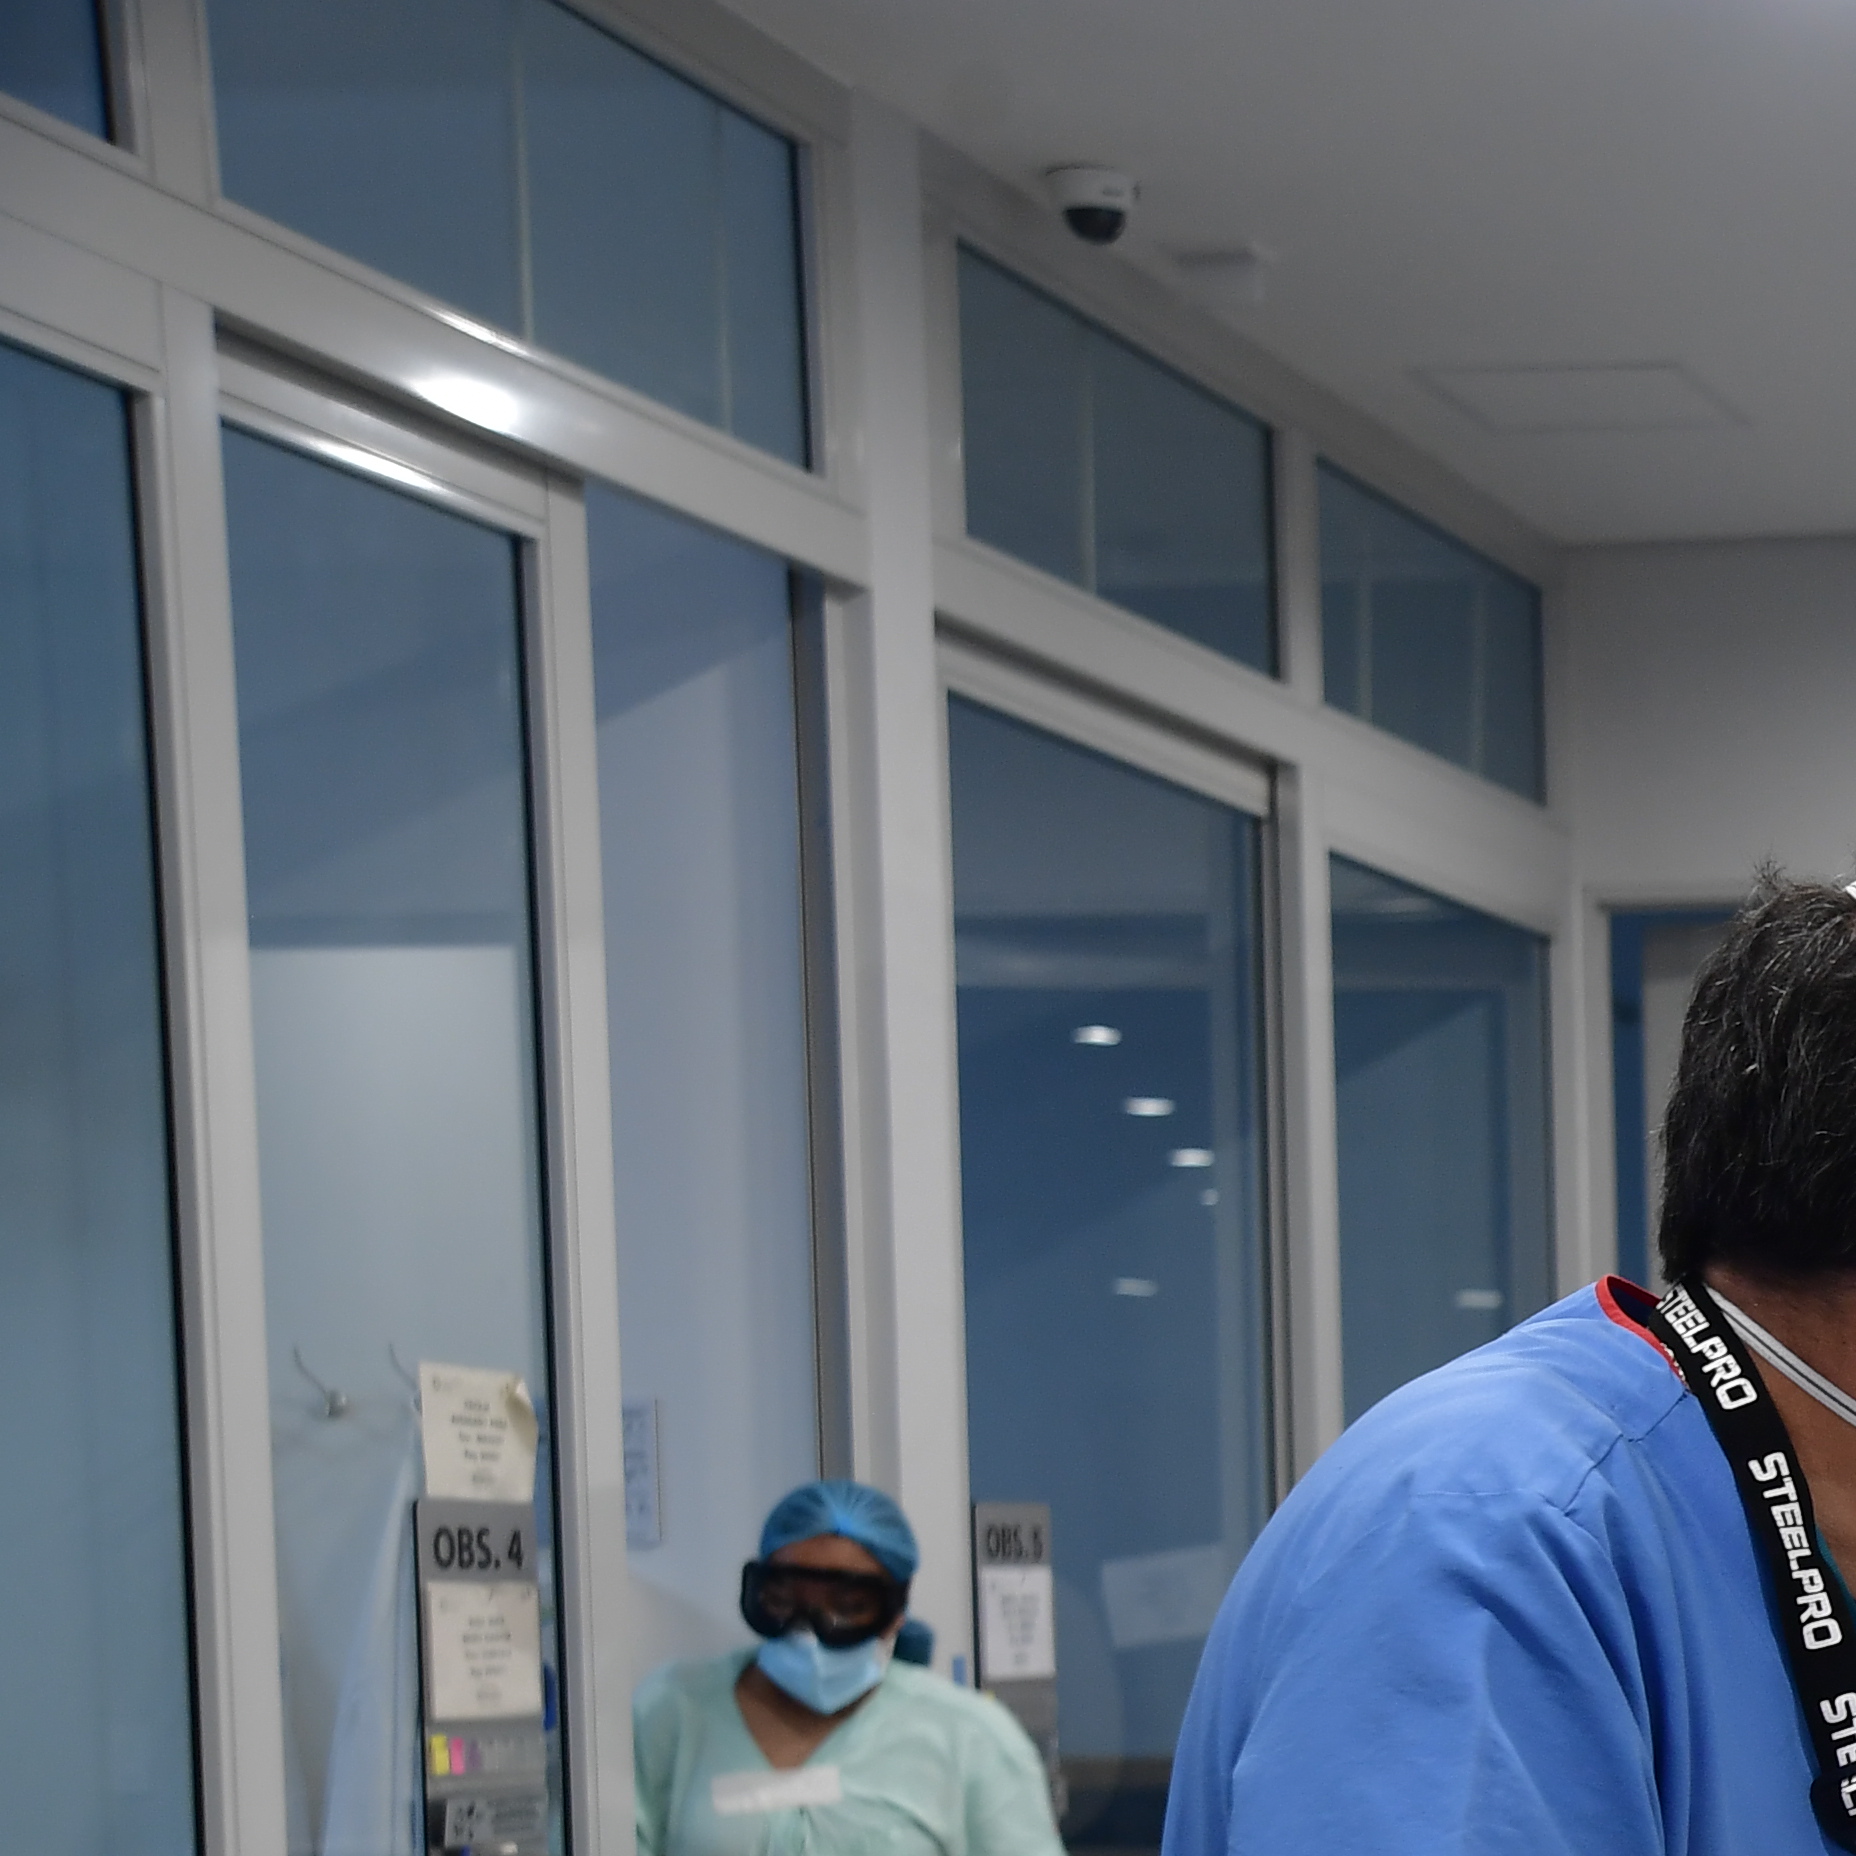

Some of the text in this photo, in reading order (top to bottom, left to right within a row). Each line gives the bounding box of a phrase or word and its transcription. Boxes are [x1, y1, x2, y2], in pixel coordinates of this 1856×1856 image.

[1656, 1285, 1757, 1410] STEELPRO
[432, 1525, 525, 1571] OBS. 4
[1748, 1451, 1843, 1650] STEELPRO
